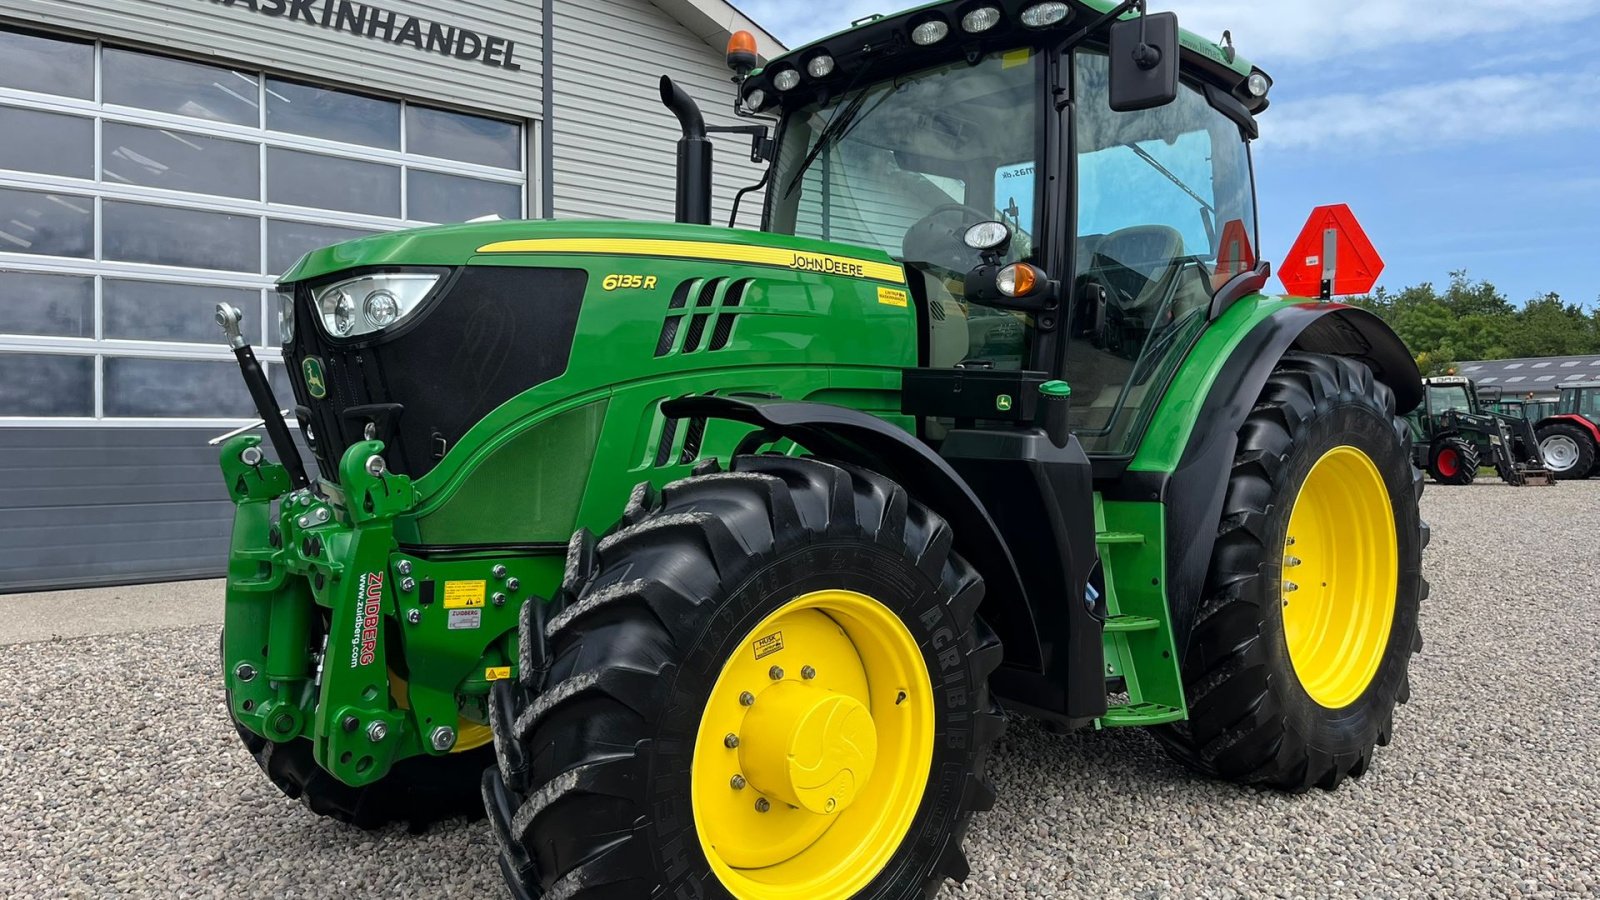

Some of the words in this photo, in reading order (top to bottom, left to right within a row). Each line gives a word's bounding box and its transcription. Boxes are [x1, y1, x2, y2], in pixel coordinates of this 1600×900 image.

[602, 274, 643, 291] 6135
[789, 253, 825, 271] JOHN
[825, 257, 864, 276] DEERE
[351, 573, 367, 668] www.zuidberg.com
[360, 571, 384, 666] ZUIDBERG
